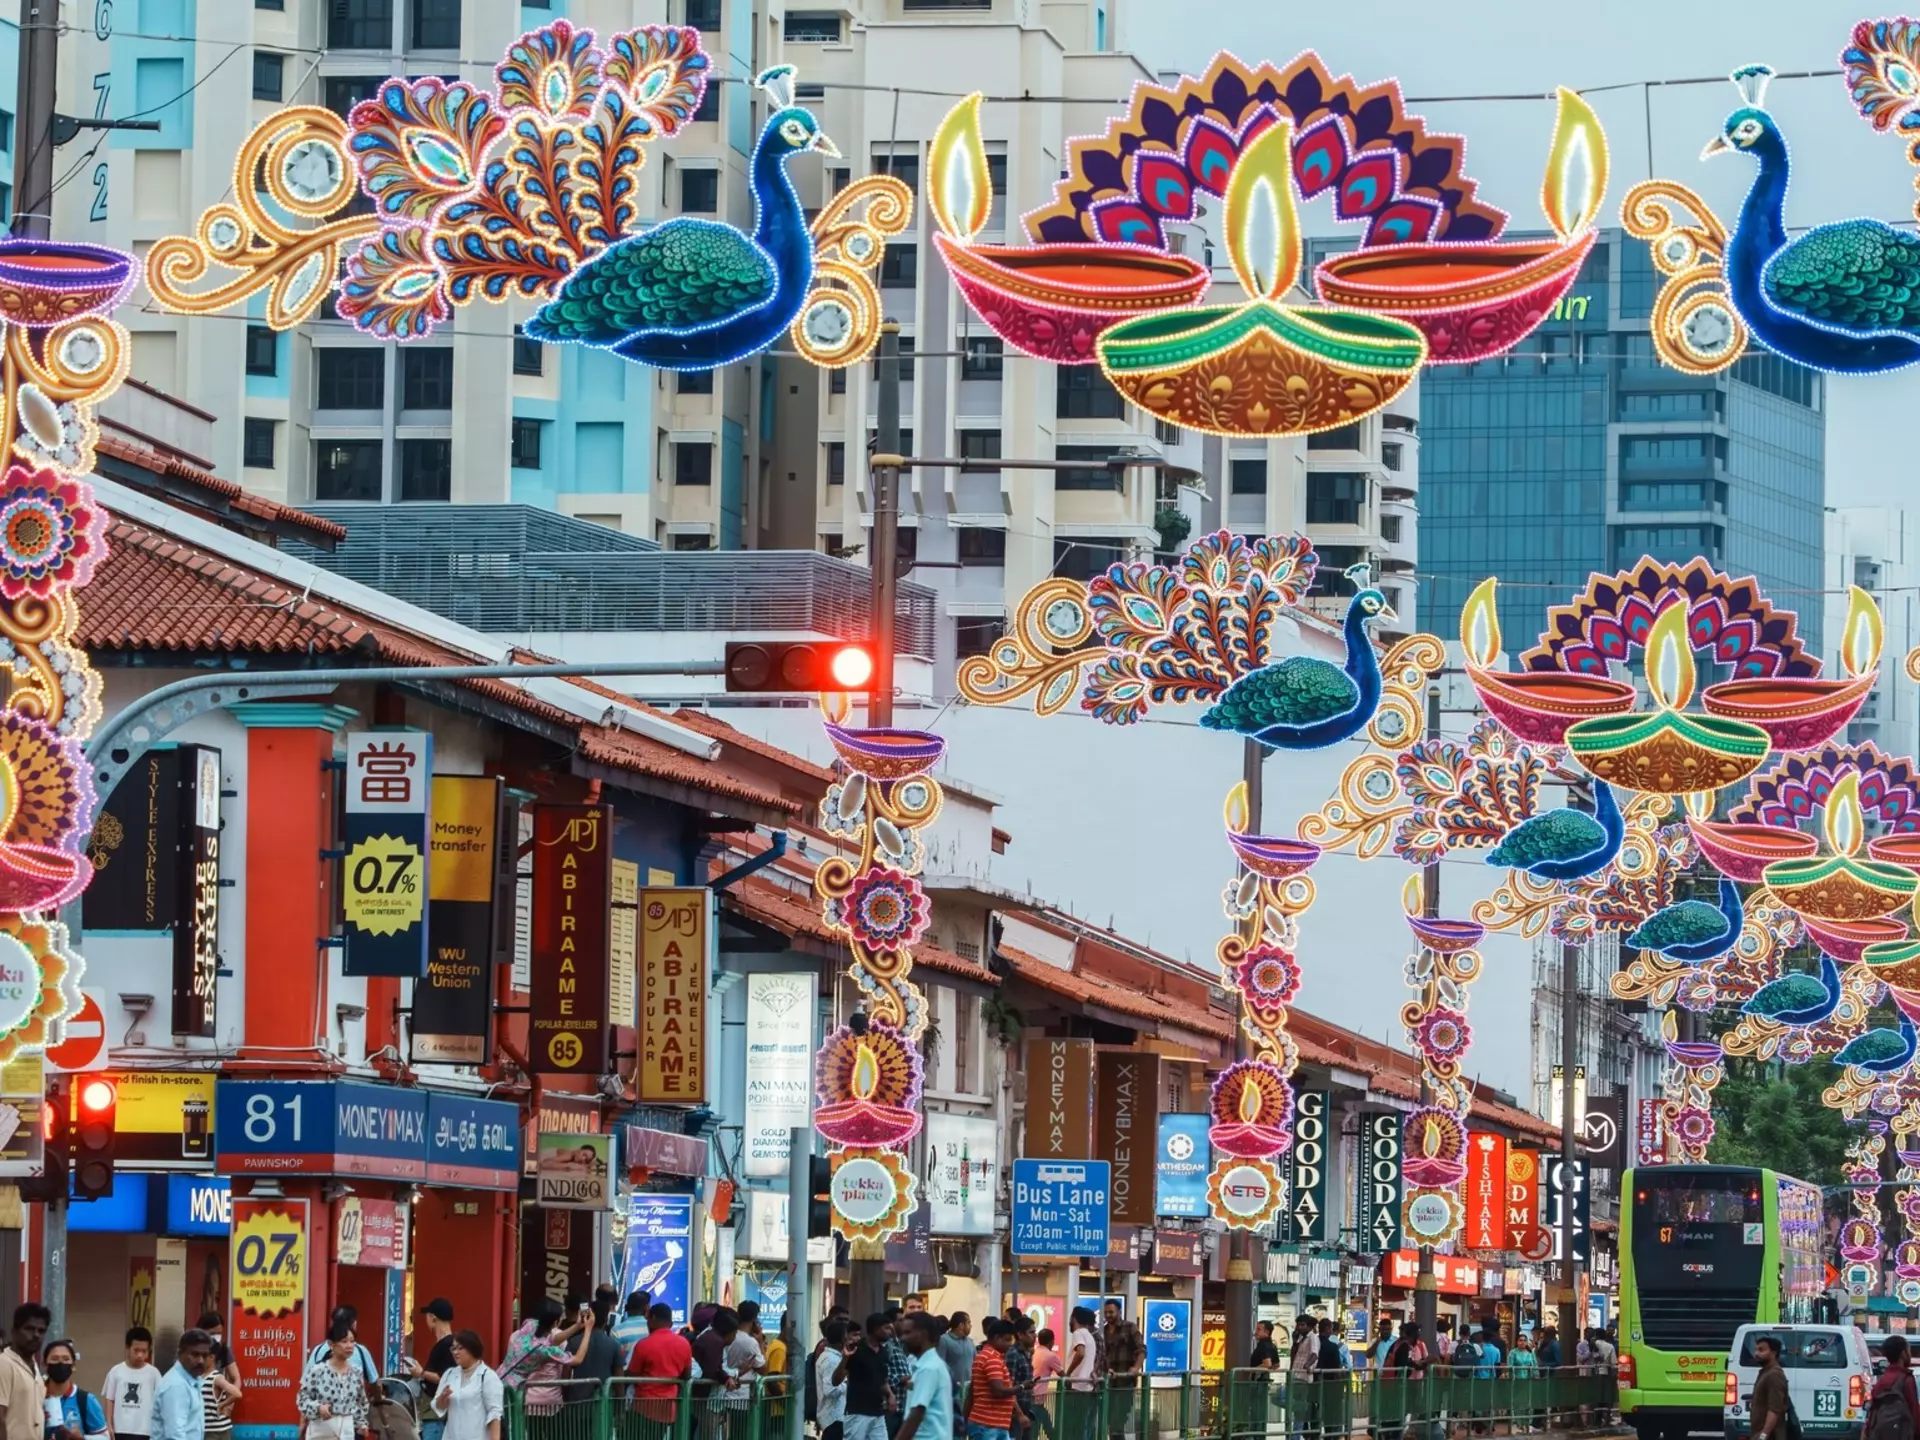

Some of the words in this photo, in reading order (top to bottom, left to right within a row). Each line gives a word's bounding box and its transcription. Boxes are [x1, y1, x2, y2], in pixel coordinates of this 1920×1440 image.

[357, 741, 416, 803] 當
[148, 758, 160, 824] STYLE
[434, 822, 482, 838] Money
[430, 839, 486, 852] transfer
[145, 827, 158, 922] EXPRESS
[361, 908, 376, 916] LOW
[377, 908, 406, 916] INTEREST
[648, 904, 663, 917] 85
[194, 862, 207, 997] STYLE
[558, 852, 577, 1016] ABIRAAME
[427, 962, 480, 976] Western
[432, 975, 471, 989] Union
[646, 962, 656, 1062] POPULAR
[659, 941, 683, 1092] ABIRAAME
[534, 1020, 562, 1029] POPULAR
[563, 1020, 597, 1030] JEWELLERS
[688, 962, 699, 1092] JEWELLERS
[553, 1040, 577, 1061] 85
[131, 1074, 158, 1084] finish
[161, 1076, 203, 1085] in-store.
[774, 1081, 807, 1091] MANI
[1050, 1041, 1066, 1153] MONEYMAX
[243, 1093, 302, 1143] 81
[761, 1128, 787, 1137] GOLD
[1639, 1100, 1653, 1165] Collection
[752, 1138, 791, 1147] DIAMON
[751, 1149, 790, 1159] GEMSTO
[244, 1157, 304, 1169] PAWNSHOP
[1293, 1092, 1325, 1238] GOODAY
[842, 1176, 884, 1190] tekka
[1372, 1115, 1400, 1250] GOODAY
[842, 1190, 883, 1203] place
[1016, 1183, 1052, 1204] Bus
[1059, 1183, 1105, 1206] Lane
[1224, 1184, 1266, 1199] NETS
[190, 1187, 231, 1224] MONE
[1479, 1152, 1493, 1247] ISHTARA
[1508, 1185, 1529, 1248] DMY
[1660, 1226, 1673, 1244] 67
[1682, 1232, 1715, 1240] MAN
[1020, 1241, 1043, 1252] Except
[1046, 1242, 1066, 1251] Public
[1070, 1243, 1100, 1252] Holidays
[545, 1252, 570, 1307] ASH
[246, 1289, 260, 1297] LOW
[261, 1289, 290, 1298] INTEREST
[1691, 1356, 1718, 1365] SMRT
[256, 1367, 278, 1376] HIGH
[243, 1378, 291, 1388] VALUATION
